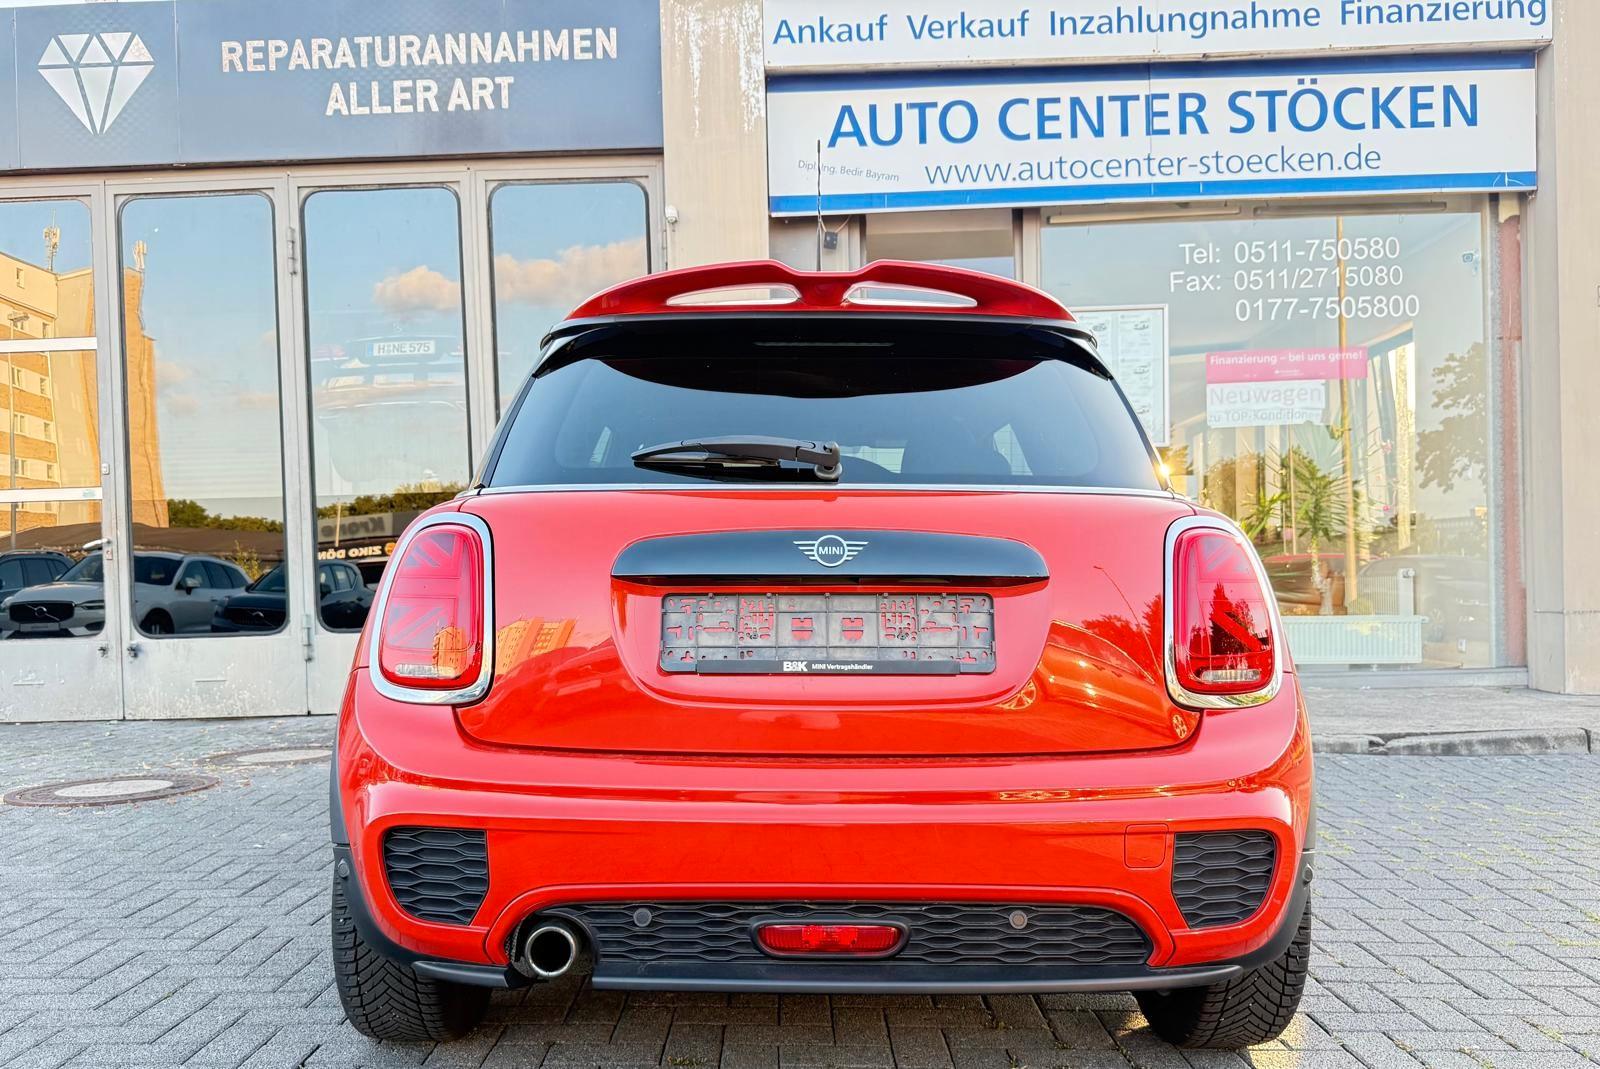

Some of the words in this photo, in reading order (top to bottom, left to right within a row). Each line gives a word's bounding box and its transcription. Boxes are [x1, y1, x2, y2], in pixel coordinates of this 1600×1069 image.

[773, 14, 887, 45] Ankauf
[907, 10, 1030, 42] Verkauf
[1049, 5, 1321, 38] Inzahlungnahme
[1340, 0, 1547, 26] Finanzierung
[221, 27, 619, 72] REPARATURANNAHMEN
[325, 80, 439, 116] ALLER
[447, 76, 514, 112] ART
[828, 99, 978, 149] AUTO
[998, 92, 1209, 142] CENTER
[1227, 77, 1480, 135] STÖCKEN
[840, 166, 863, 176] Bedir
[866, 169, 900, 182] Bayram
[924, 145, 1382, 185] www.autocenter-stoecken.de
[1179, 243, 1221, 264] Tel:
[1234, 237, 1400, 263] 0511-750580
[1170, 270, 1221, 293] Fax:
[1234, 265, 1403, 291] 0511/2715080
[1235, 295, 1420, 322] 0177-7505800
[1210, 353, 1278, 366] Finanzierung
[1288, 351, 1304, 362] bei
[1307, 353, 1326, 361] uns
[1328, 350, 1362, 363] gerne!
[1210, 387, 1322, 406] Neuwagen
[818, 546, 843, 555] MINI
[783, 661, 808, 672] B&K
